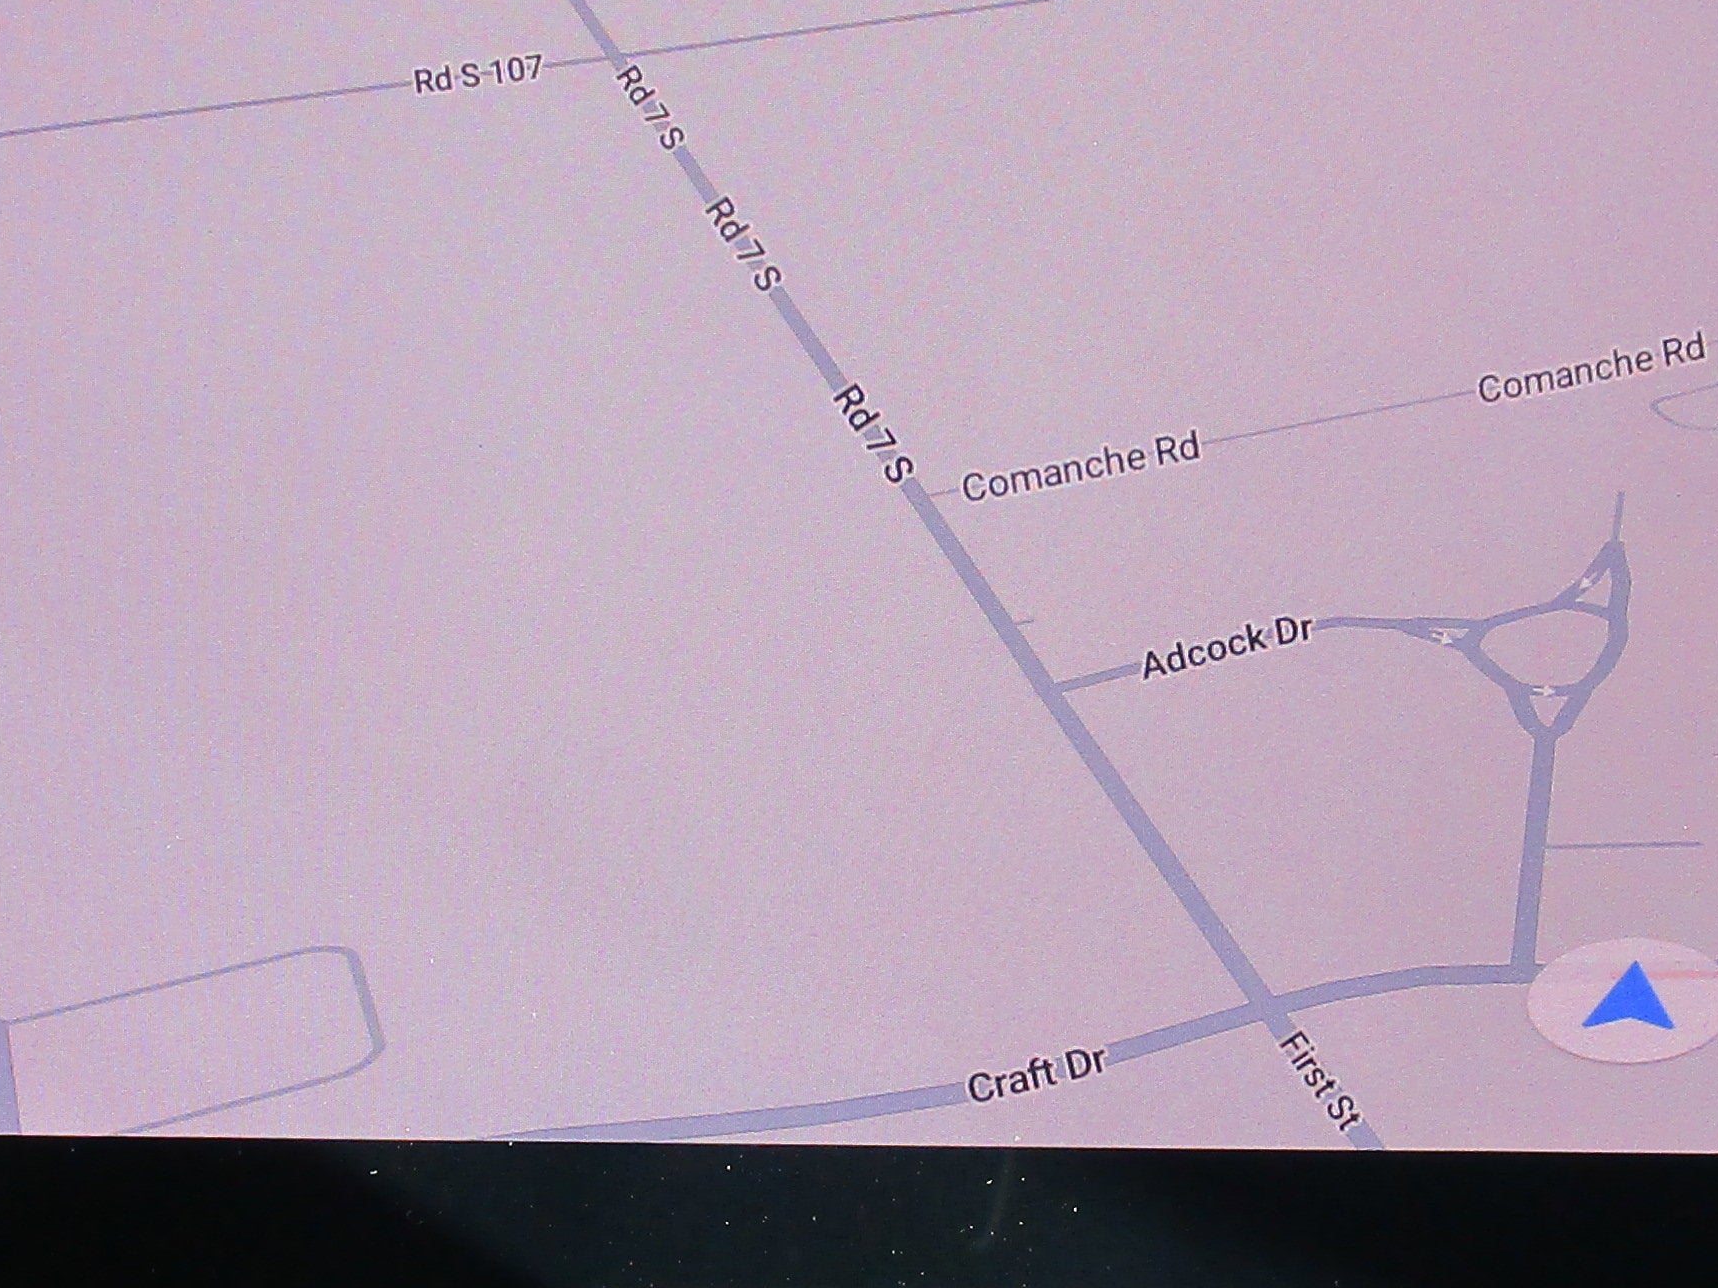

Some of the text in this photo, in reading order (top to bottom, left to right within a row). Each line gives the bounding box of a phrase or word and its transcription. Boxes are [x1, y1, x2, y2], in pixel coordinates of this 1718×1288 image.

[414, 56, 543, 94] Rd S 107
[616, 65, 684, 150] Rd 7 S
[706, 197, 781, 292] Rd 7 S
[1479, 332, 1706, 403] Comanche Rd
[834, 384, 913, 484] Rd 7 S
[962, 431, 1201, 501] Comanche Rd
[1141, 614, 1313, 678] Adcock Dr
[967, 1046, 1108, 1103] Craft Dr
[1280, 1031, 1361, 1132] First St
